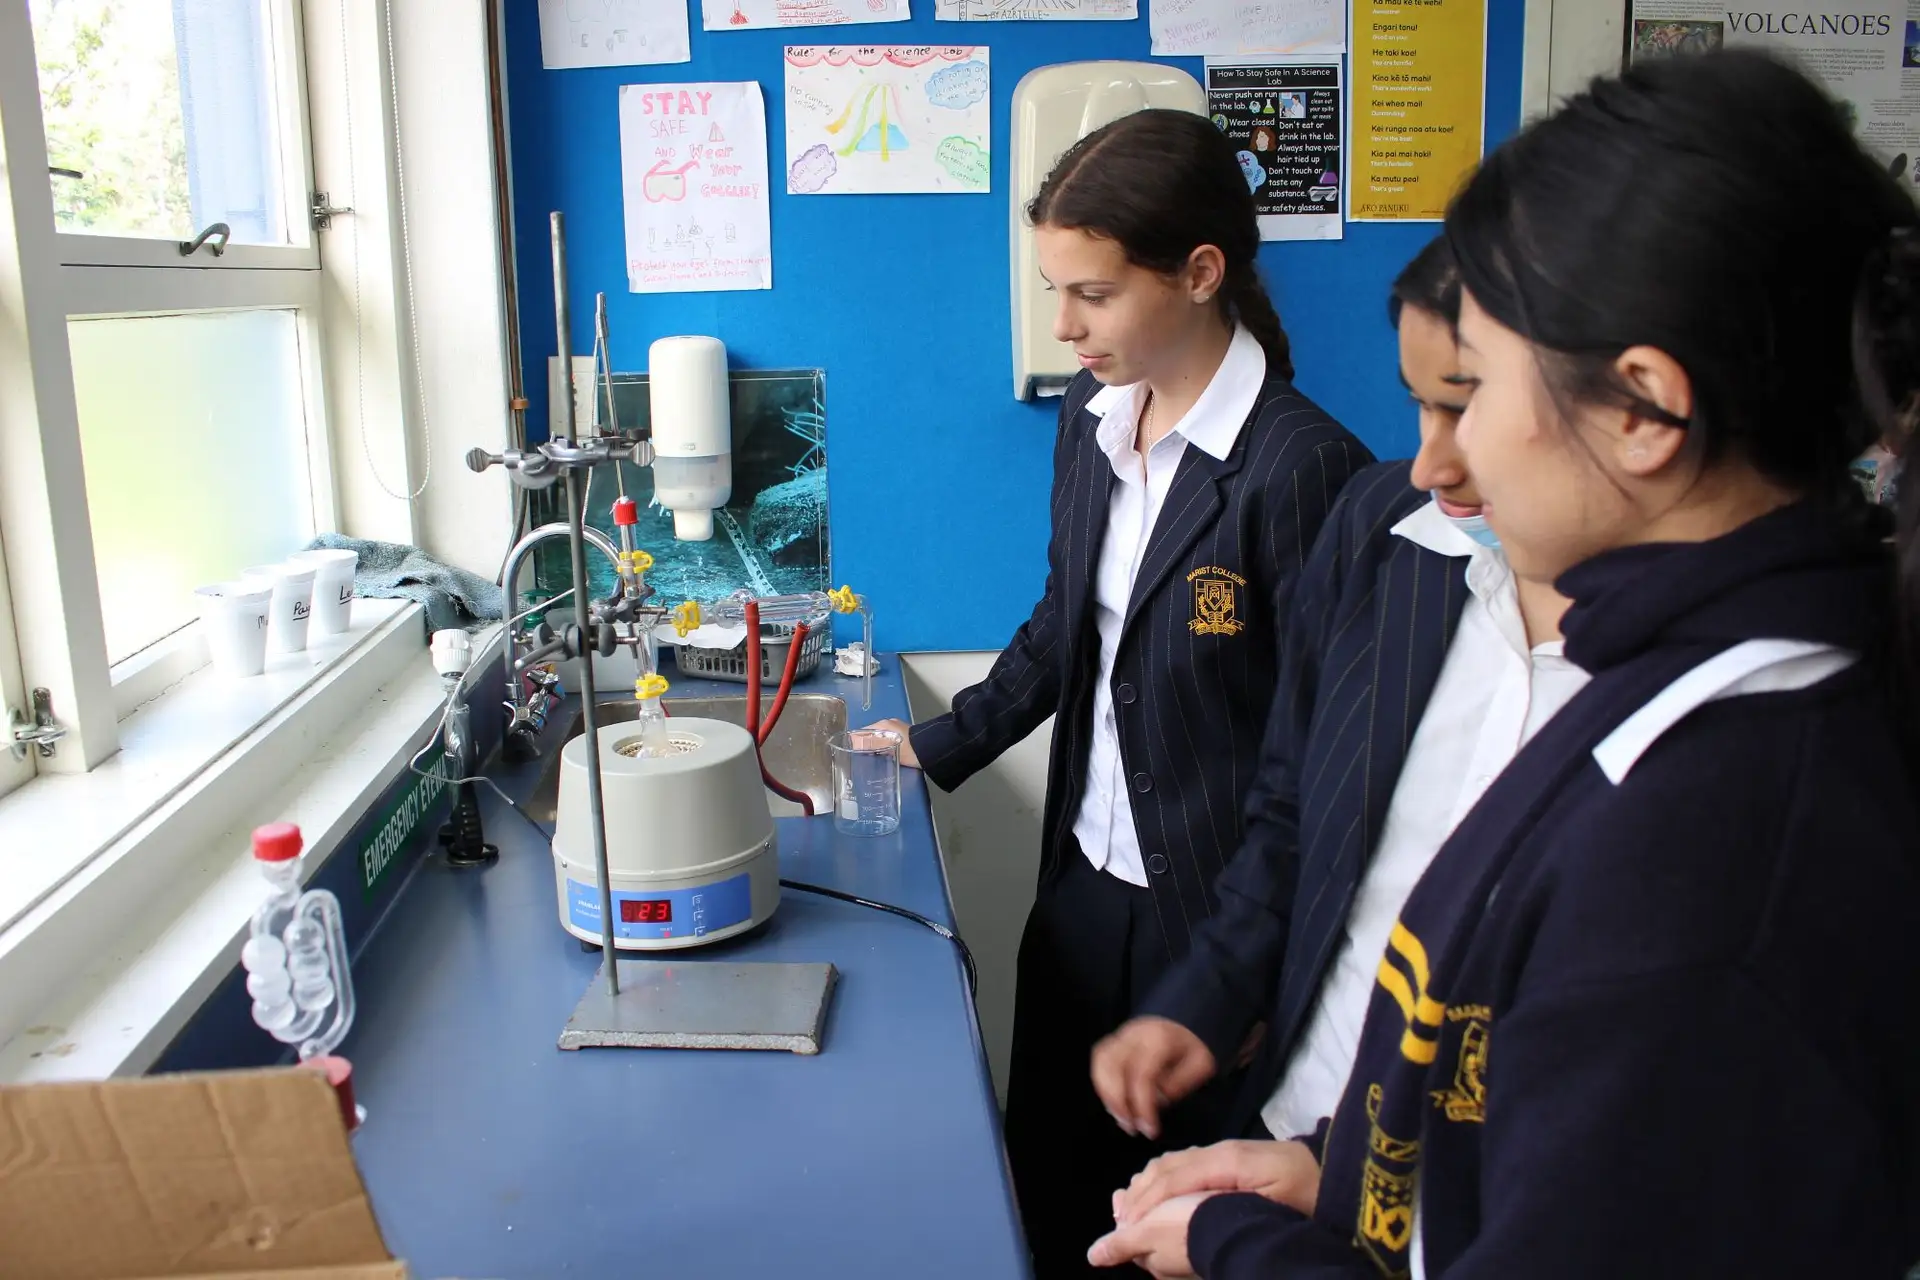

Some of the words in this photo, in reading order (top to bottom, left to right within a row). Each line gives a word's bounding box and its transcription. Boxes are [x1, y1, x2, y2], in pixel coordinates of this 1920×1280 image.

[1372, 23, 1398, 32] Engari
[1727, 12, 1891, 36] VOLCANOES
[787, 47, 815, 57] Rules
[828, 48, 842, 57] for
[858, 47, 875, 55] the
[1217, 70, 1235, 78] How
[1235, 69, 1245, 77] To
[1246, 69, 1263, 79] Stay
[1301, 68, 1331, 76] Science
[1209, 91, 1234, 99] Never
[1235, 91, 1253, 100] push
[641, 90, 712, 115] STAY
[1219, 102, 1233, 110] the
[1234, 101, 1248, 110] lab.
[1229, 118, 1249, 127] Wear
[1251, 118, 1275, 126] closed
[1279, 121, 1300, 130] Don't
[650, 119, 689, 139] SAFE
[1385, 125, 1407, 134] runga
[1229, 130, 1250, 138] shoes
[1279, 132, 1299, 140] drink
[1323, 132, 1337, 140] lab.
[655, 146, 676, 157] AND
[1278, 144, 1303, 153] Always
[1305, 144, 1322, 152] have
[1323, 145, 1340, 153] your
[1277, 155, 1293, 163] hair
[1294, 155, 1309, 163] tied
[1311, 156, 1320, 165] up
[1268, 167, 1290, 175] Don't
[1292, 167, 1312, 175] touch
[1290, 179, 1303, 188] any
[1268, 190, 1307, 198] substance.
[1256, 204, 1270, 212] ear
[1272, 204, 1296, 213] safety
[1297, 204, 1326, 213] glasses.
[1361, 203, 1378, 212] AKO
[1379, 203, 1410, 213] PANUKU
[1186, 566, 1210, 583] MARIST
[1211, 566, 1247, 587] COLLEGE
[364, 785, 419, 887] EMERGENCY
[420, 753, 449, 812] EYEWA
[638, 903, 669, 920] 23
